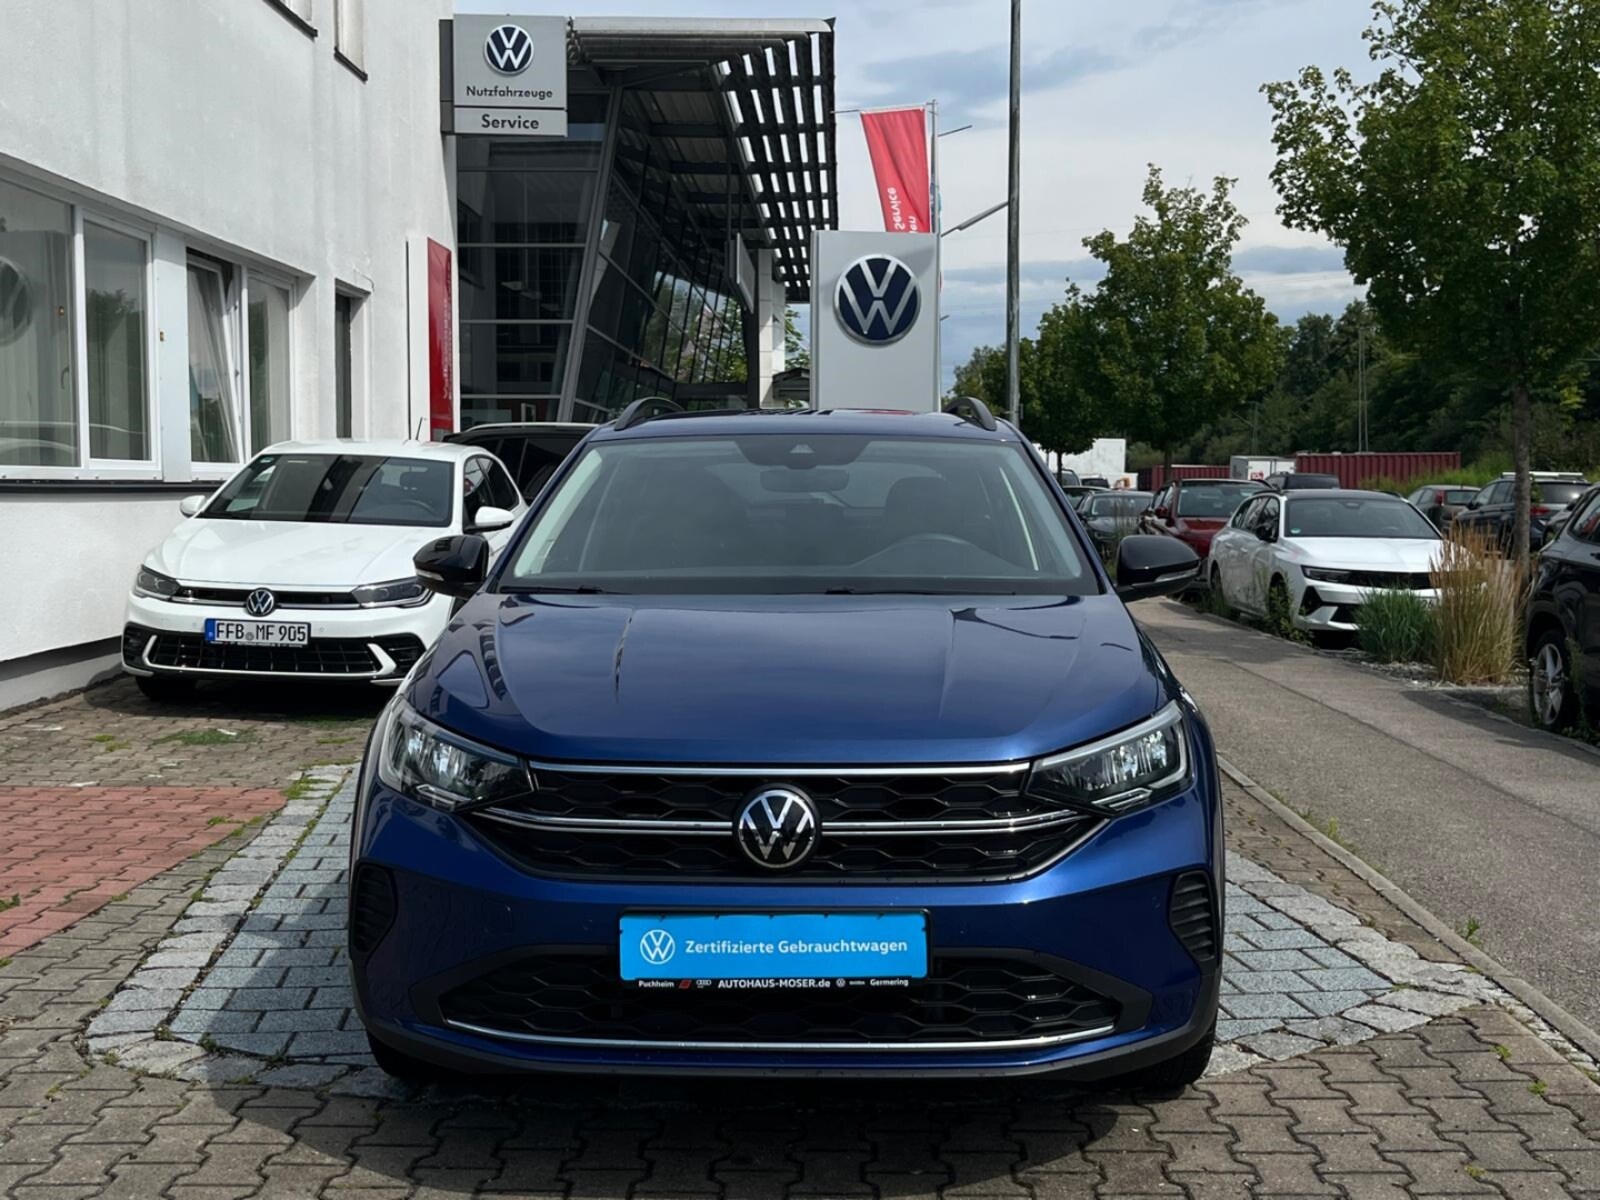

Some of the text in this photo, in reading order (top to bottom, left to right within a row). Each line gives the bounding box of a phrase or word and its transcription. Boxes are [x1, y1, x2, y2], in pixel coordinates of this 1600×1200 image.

[466, 86, 553, 100] Nutzfahrzeuge
[481, 113, 540, 129] Service
[216, 622, 306, 642] FFB MF 905
[685, 939, 908, 955] Zertifizierte Gebrauchtwagen
[638, 980, 675, 989] Puchheim
[718, 979, 831, 989] AUTOHAUS-MOSER.de
[870, 978, 909, 987] Germering
